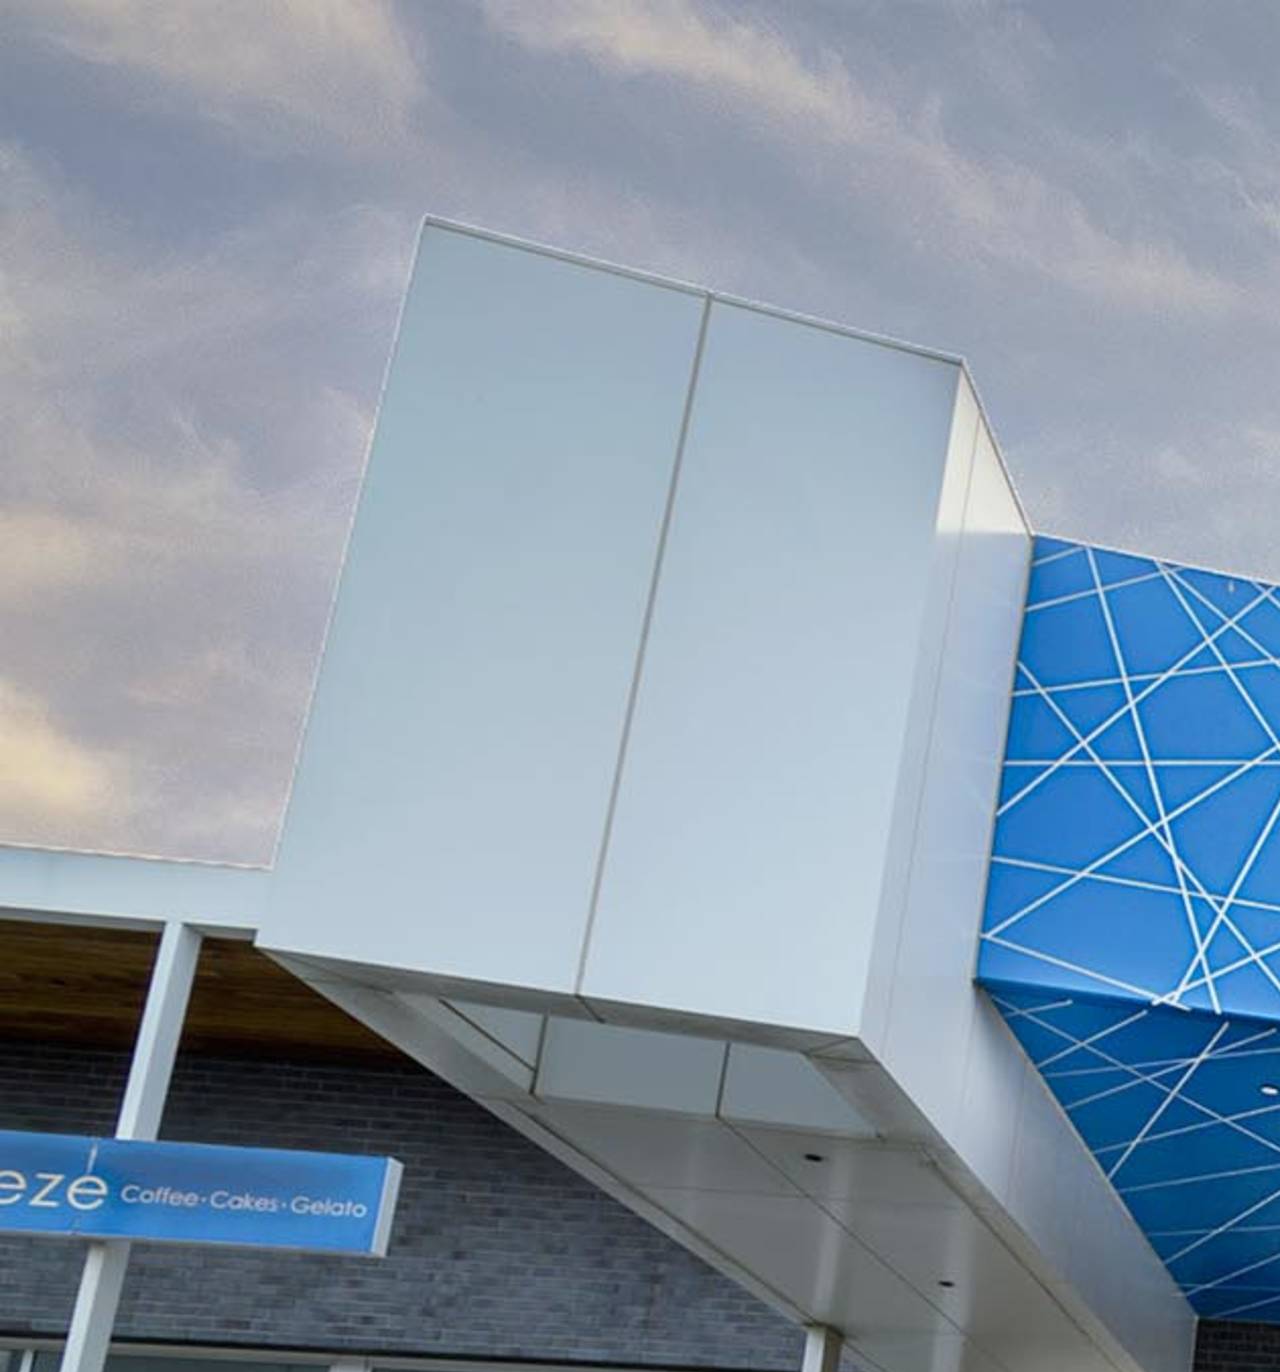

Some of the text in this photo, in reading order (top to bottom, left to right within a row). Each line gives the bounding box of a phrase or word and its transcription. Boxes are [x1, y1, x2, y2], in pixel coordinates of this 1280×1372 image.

[0, 1170, 367, 1219] eze Coffee Cakes Gelato
